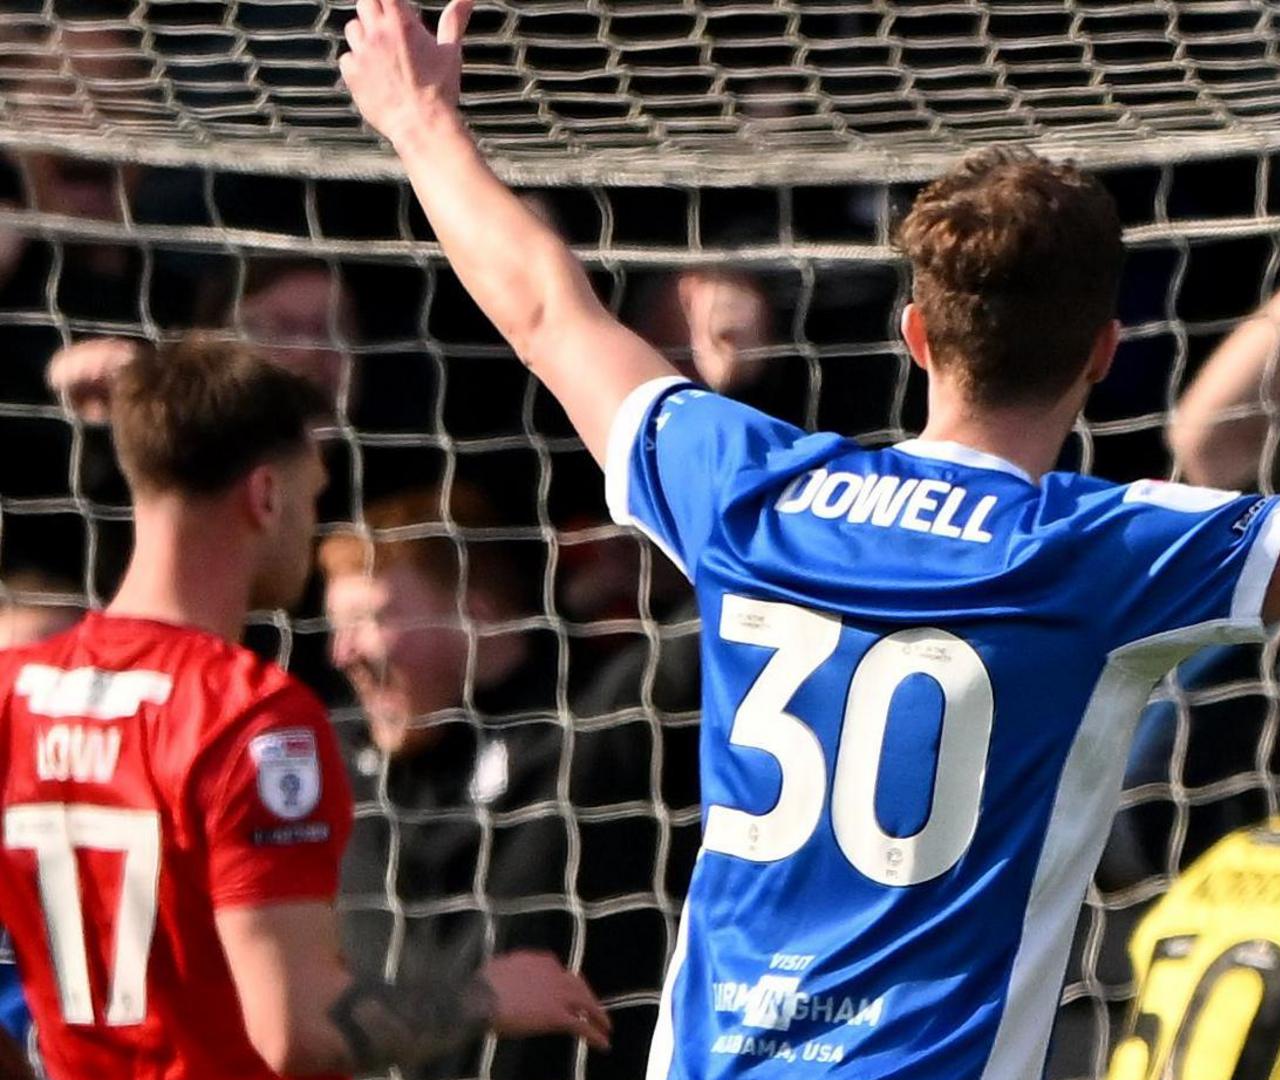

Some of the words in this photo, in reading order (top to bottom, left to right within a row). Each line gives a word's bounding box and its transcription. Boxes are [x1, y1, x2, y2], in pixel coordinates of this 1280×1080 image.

[702, 592, 995, 887] 30
[4, 801, 163, 1027] 17
[768, 952, 816, 972] VISIT
[801, 1042, 845, 1063] USA
